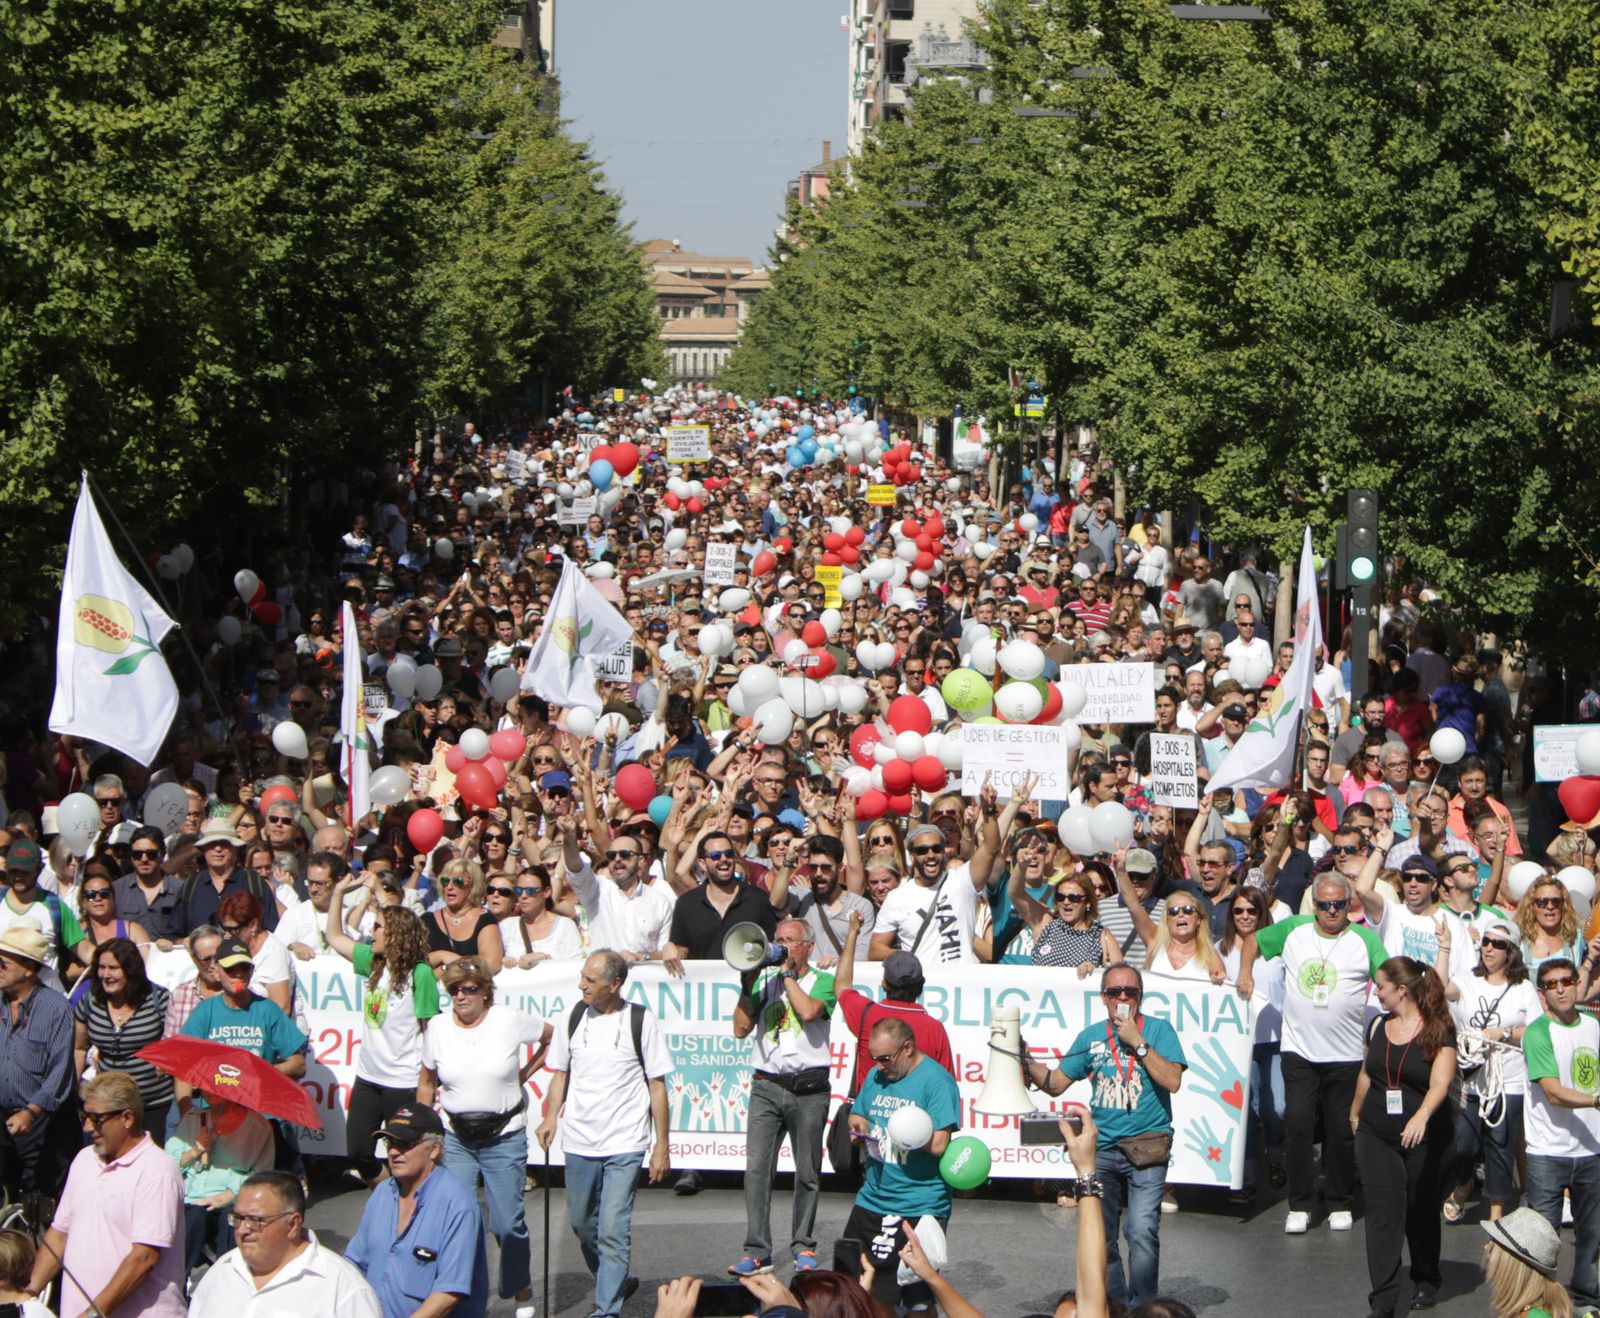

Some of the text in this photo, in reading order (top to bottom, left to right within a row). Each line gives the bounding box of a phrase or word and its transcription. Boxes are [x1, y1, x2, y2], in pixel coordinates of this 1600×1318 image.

[596, 659, 628, 675] ALUD.
[1153, 760, 1194, 777] HOSPITALES
[1155, 781, 1195, 798] COMPLETOS
[208, 1025, 263, 1040] JUSTICIA
[948, 1146, 972, 1175] yoigo
